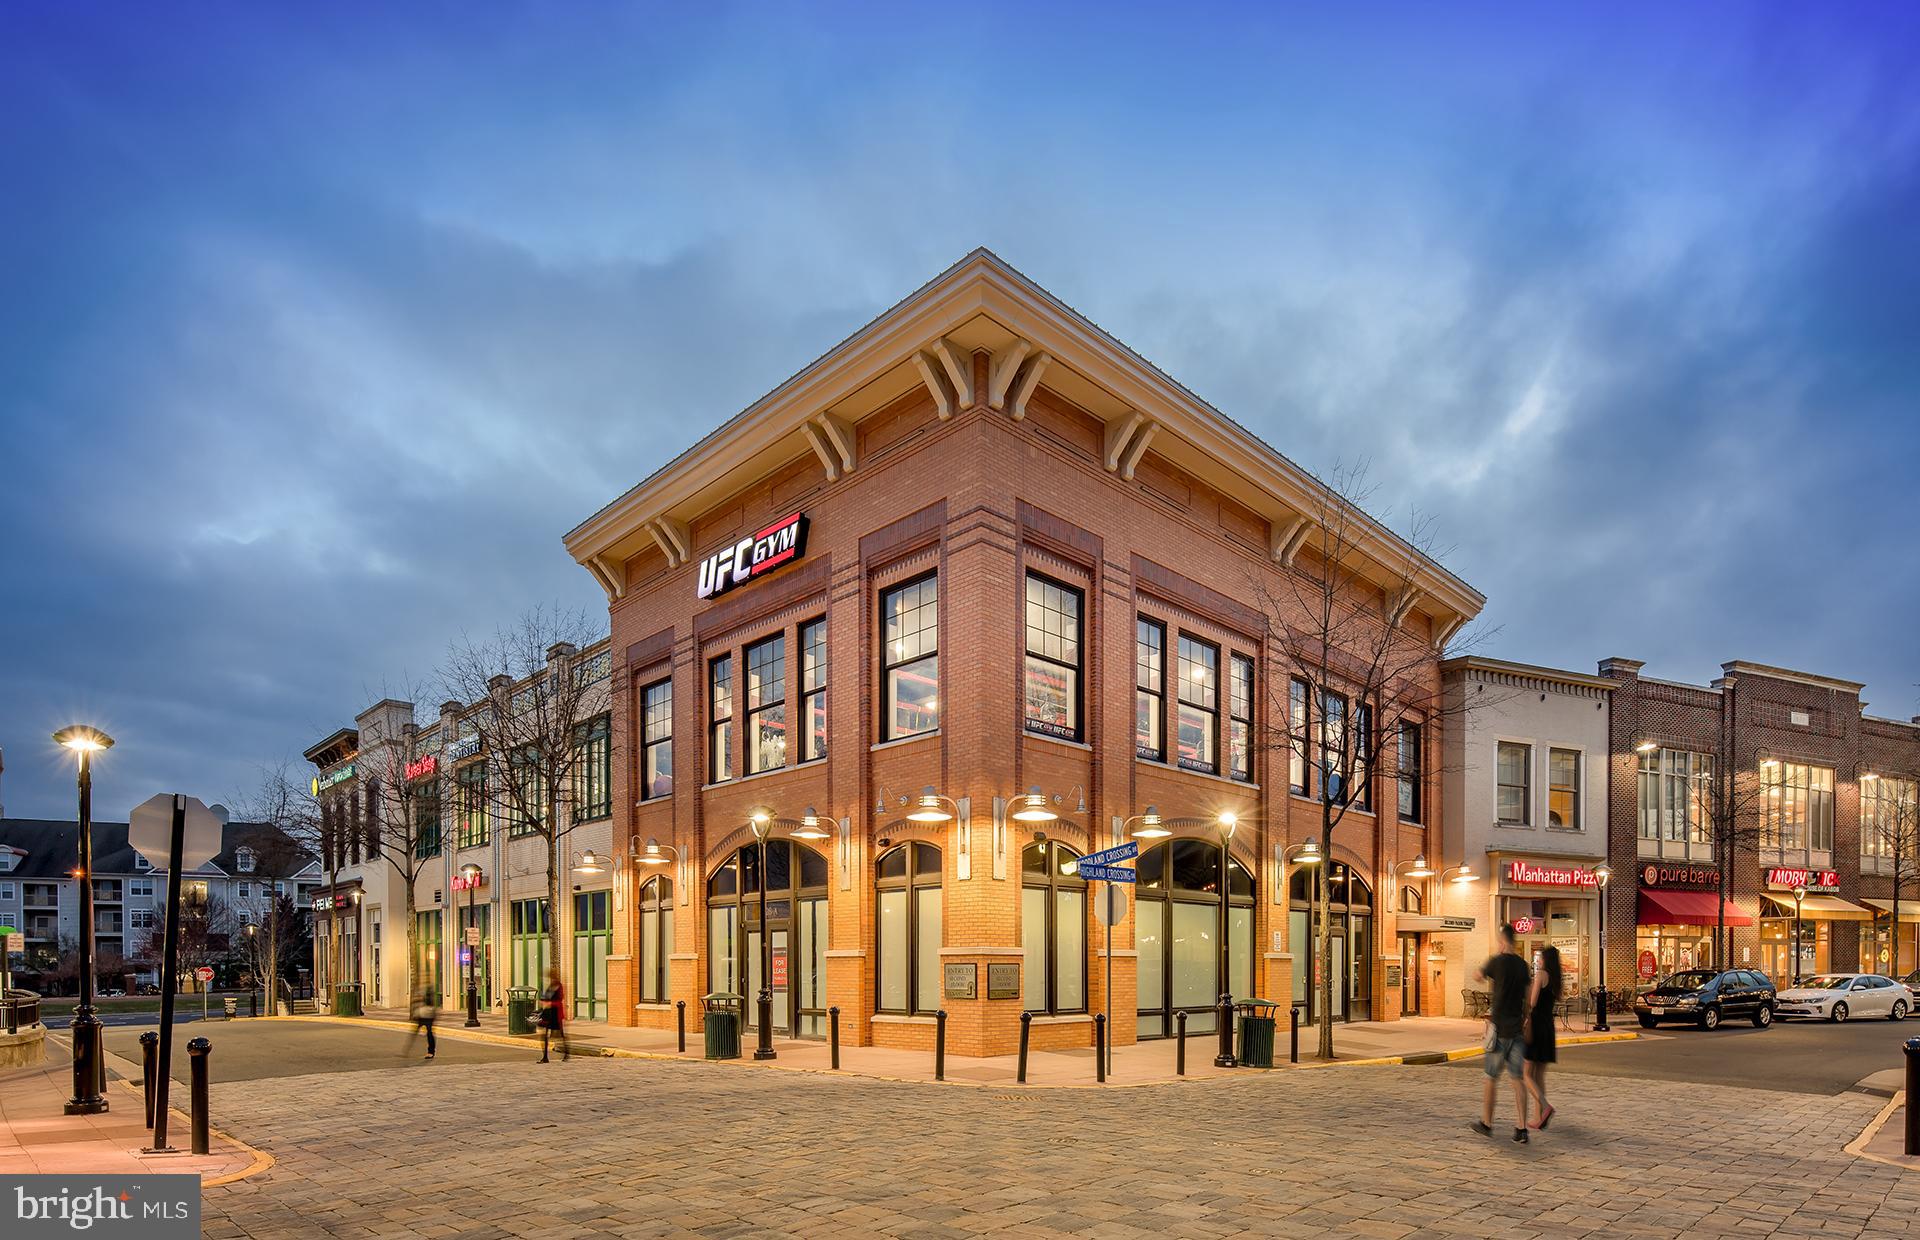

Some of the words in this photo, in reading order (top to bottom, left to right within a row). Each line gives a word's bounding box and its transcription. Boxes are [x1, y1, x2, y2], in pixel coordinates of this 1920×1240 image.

[698, 537, 753, 599] UFC
[752, 521, 799, 565] GYM
[1106, 846, 1131, 862] CROSSING
[1107, 868, 1131, 880] CROSSING
[1513, 862, 1571, 884] Manhattan
[1660, 868, 1688, 886] pure
[1689, 866, 1720, 885] barre
[1774, 869, 1808, 887] MOBY
[1515, 920, 1534, 934] OPEN
[1642, 966, 1653, 974] FREE
